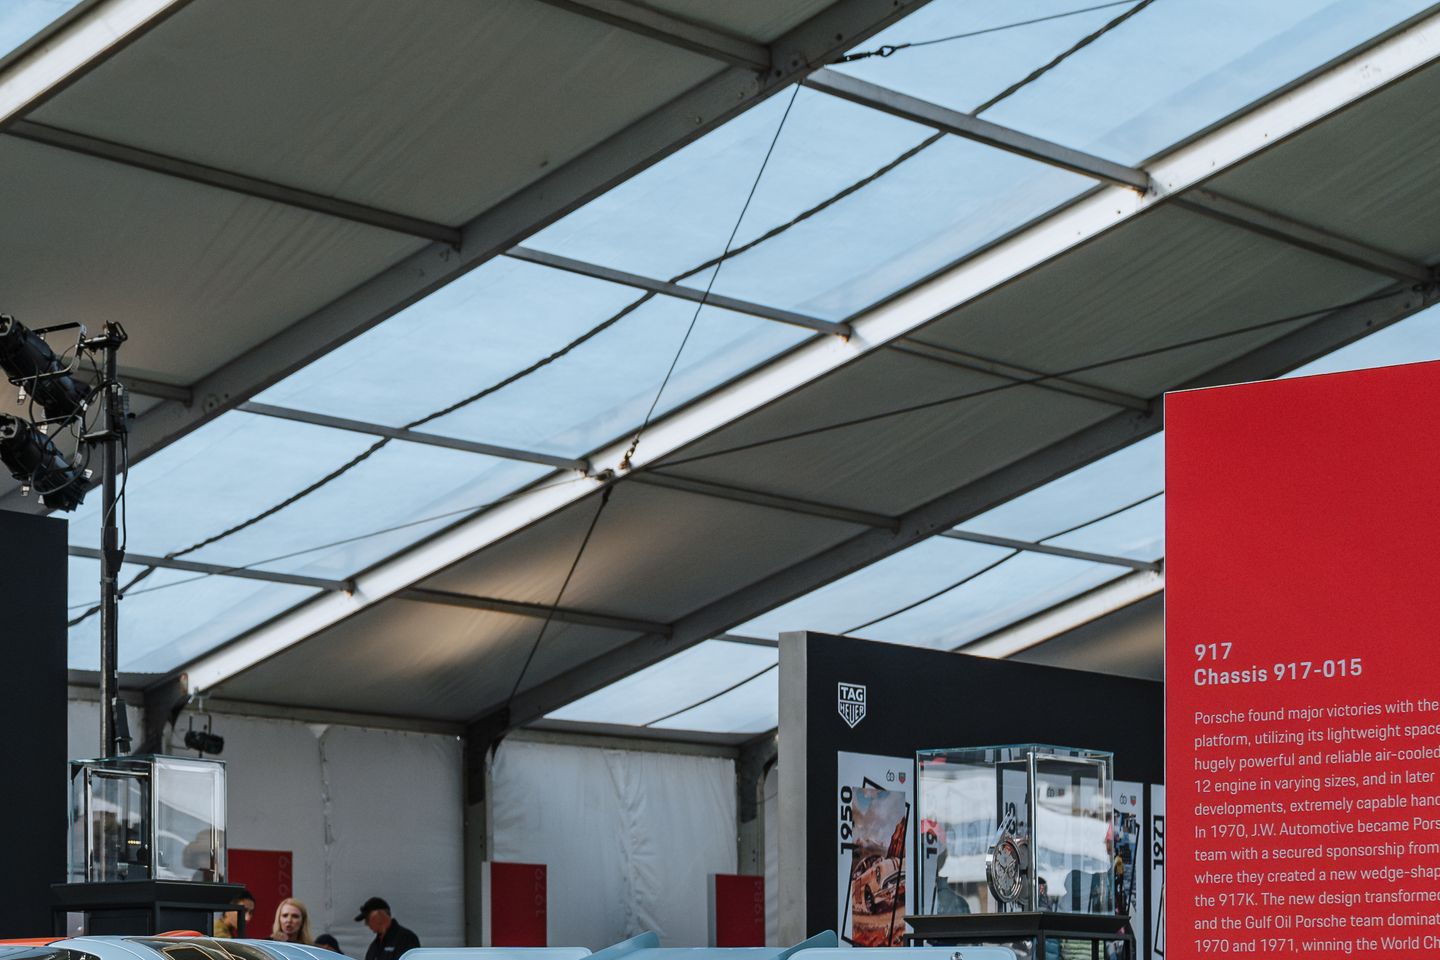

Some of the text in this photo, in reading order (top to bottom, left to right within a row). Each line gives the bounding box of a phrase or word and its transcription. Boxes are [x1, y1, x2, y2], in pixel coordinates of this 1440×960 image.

[1194, 642, 1232, 661] 917
[1194, 658, 1362, 685] Chassis 917-015
[841, 686, 864, 702] TAG
[840, 703, 864, 724] HEUER
[1195, 698, 1439, 724] Porsche found major victories with the
[1194, 733, 1251, 750] platform,
[1255, 730, 1304, 745] utilizing
[1308, 728, 1323, 741] its
[1327, 724, 1401, 743] lightweight
[1194, 756, 1236, 772] hugely
[1239, 752, 1294, 771] powerful
[1298, 751, 1321, 765] and
[1325, 749, 1371, 763] reliable
[1194, 770, 1435, 794] 12 engine in varying sizes, and in later
[1194, 801, 1286, 817] developments,
[1290, 797, 1353, 813] extremely
[1356, 794, 1407, 812] capable
[841, 785, 854, 855] 1950
[1195, 825, 1206, 838] In
[1211, 823, 1248, 838] 1970,
[1251, 823, 1276, 836] J.W.
[1279, 820, 1353, 835] Automotive
[1357, 819, 1409, 832] became
[1153, 815, 1164, 870] 1971
[1194, 841, 1439, 861] team with a secured sponsorship from
[1194, 871, 1233, 883] where
[1236, 870, 1264, 885] they
[1267, 868, 1315, 882] created
[1319, 871, 1326, 880] a
[1330, 870, 1357, 880] new
[1194, 894, 1215, 907] the
[1218, 892, 1257, 906] 917K.
[1261, 892, 1284, 905] The
[1288, 894, 1315, 904] new
[1318, 890, 1361, 906] design
[1194, 916, 1217, 929] and
[1221, 916, 1241, 929] the
[1245, 915, 1272, 928] Gulf
[1274, 915, 1291, 928] Oil
[1295, 914, 1346, 928] Porsche
[1350, 915, 1383, 926] team
[1194, 939, 1229, 952] 1970
[1232, 939, 1255, 952] and
[1260, 938, 1298, 953] 1971,
[1302, 937, 1352, 954] winning
[1356, 937, 1377, 950] the
[1380, 936, 1419, 949] World
